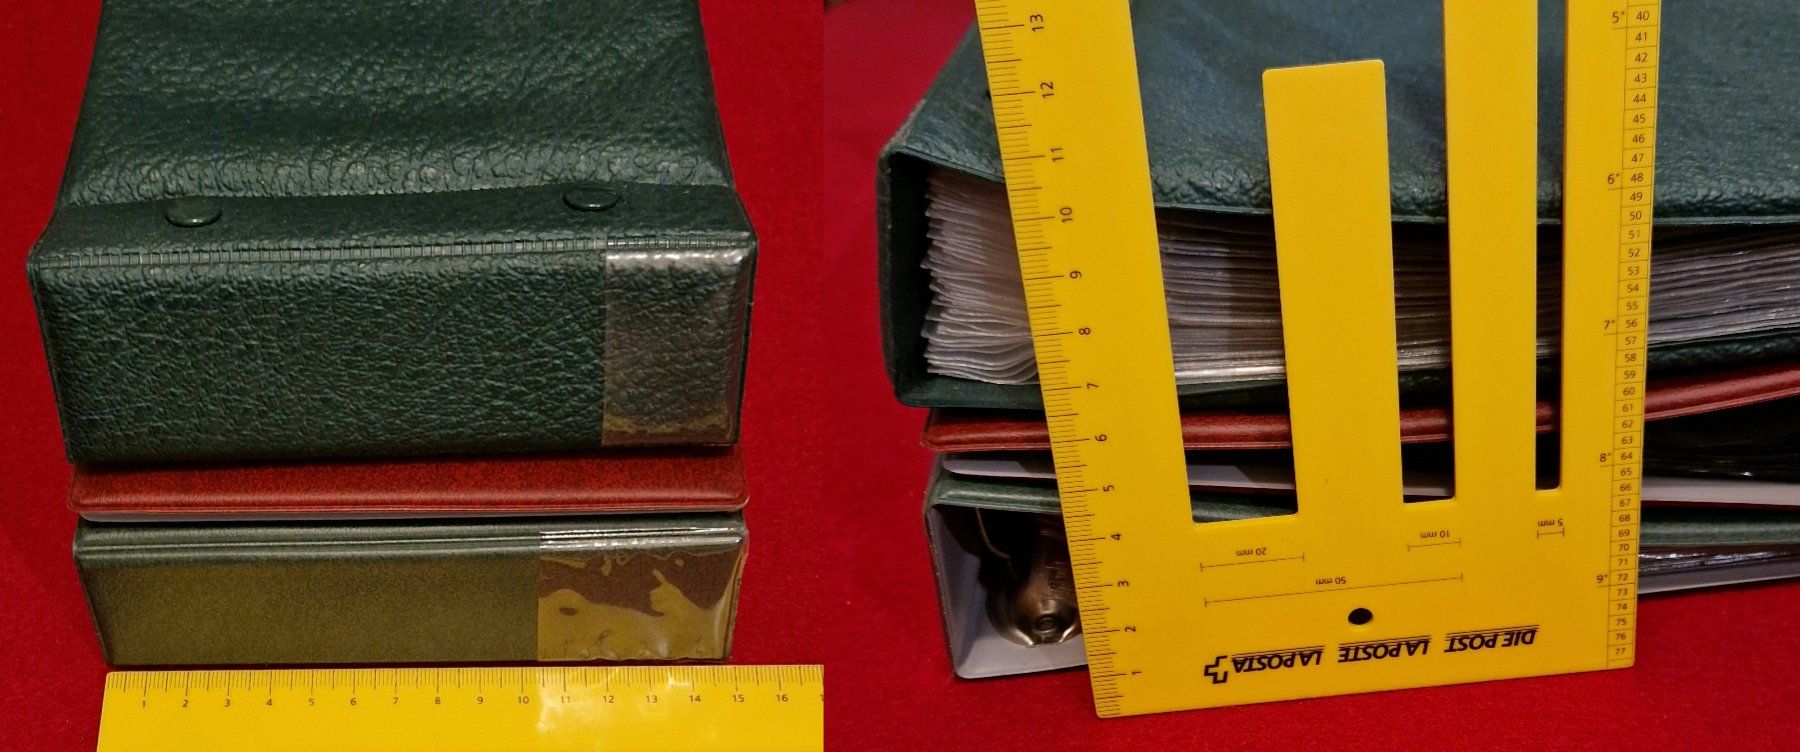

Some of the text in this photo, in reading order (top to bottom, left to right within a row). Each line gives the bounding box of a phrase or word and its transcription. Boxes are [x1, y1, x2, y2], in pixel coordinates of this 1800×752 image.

[1635, 10, 1650, 22] 40
[1029, 14, 1045, 32] 13
[1634, 31, 1648, 43] 41
[1634, 52, 1648, 63] 42
[1633, 73, 1648, 84] 43
[1633, 93, 1647, 104] 44
[1632, 113, 1646, 124] 45
[1631, 133, 1646, 144] 46
[1050, 147, 1065, 163] 11
[1630, 153, 1645, 164] 47
[1630, 172, 1644, 184] 48
[1629, 191, 1643, 202] 49
[1059, 206, 1074, 224] 10
[1629, 210, 1642, 221] 50
[1628, 229, 1640, 240] 51
[1628, 248, 1641, 258] 52
[1069, 270, 1082, 280] 9
[1627, 265, 1640, 276] 53
[1626, 283, 1640, 294] 54
[1626, 300, 1639, 311] 55
[1625, 318, 1638, 329] 56
[1078, 327, 1091, 336] 8
[1624, 335, 1637, 346] 57
[1624, 353, 1637, 363] 58
[1623, 369, 1636, 380] 59
[1086, 382, 1099, 390] 7
[1622, 386, 1636, 396] 60
[1622, 403, 1634, 413] 61
[1621, 419, 1634, 429] 62
[1094, 434, 1108, 442] 6
[1621, 435, 1634, 445] 63
[1620, 451, 1633, 461] 64
[1620, 467, 1633, 477] 65
[1102, 485, 1115, 493] 5
[1619, 483, 1632, 492] 66
[1619, 498, 1631, 508] 67
[1537, 518, 1564, 527] 5 mm
[1618, 513, 1631, 523] 68
[1110, 533, 1122, 541] 4
[1419, 530, 1450, 539] 10 mm
[1618, 528, 1631, 538] 69
[1235, 547, 1268, 557] 20 mm
[1617, 543, 1630, 552] 70
[1617, 558, 1629, 567] 71
[1334, 576, 1347, 585] 50
[1617, 573, 1630, 582] 72
[1117, 580, 1130, 588] 3
[1617, 588, 1629, 597] 73
[1616, 602, 1628, 611] 74
[1616, 617, 1627, 626] 75
[1615, 632, 1627, 641] 76
[1231, 627, 1537, 673] DIE POST LA POSTE LA POSTA
[1615, 647, 1626, 655] 77
[182, 699, 189, 708] 2
[224, 698, 231, 708] 3
[266, 698, 273, 706] 4
[308, 697, 315, 707] 5
[350, 697, 357, 706] 6
[392, 696, 399, 705] 7
[434, 696, 442, 705] 8
[476, 696, 484, 705] 9
[517, 695, 530, 705] 10
[560, 695, 571, 704] 11
[602, 694, 615, 704] 12
[645, 694, 658, 704] 13
[689, 694, 702, 703] 14
[732, 694, 745, 703] 15
[776, 693, 789, 703] 16
